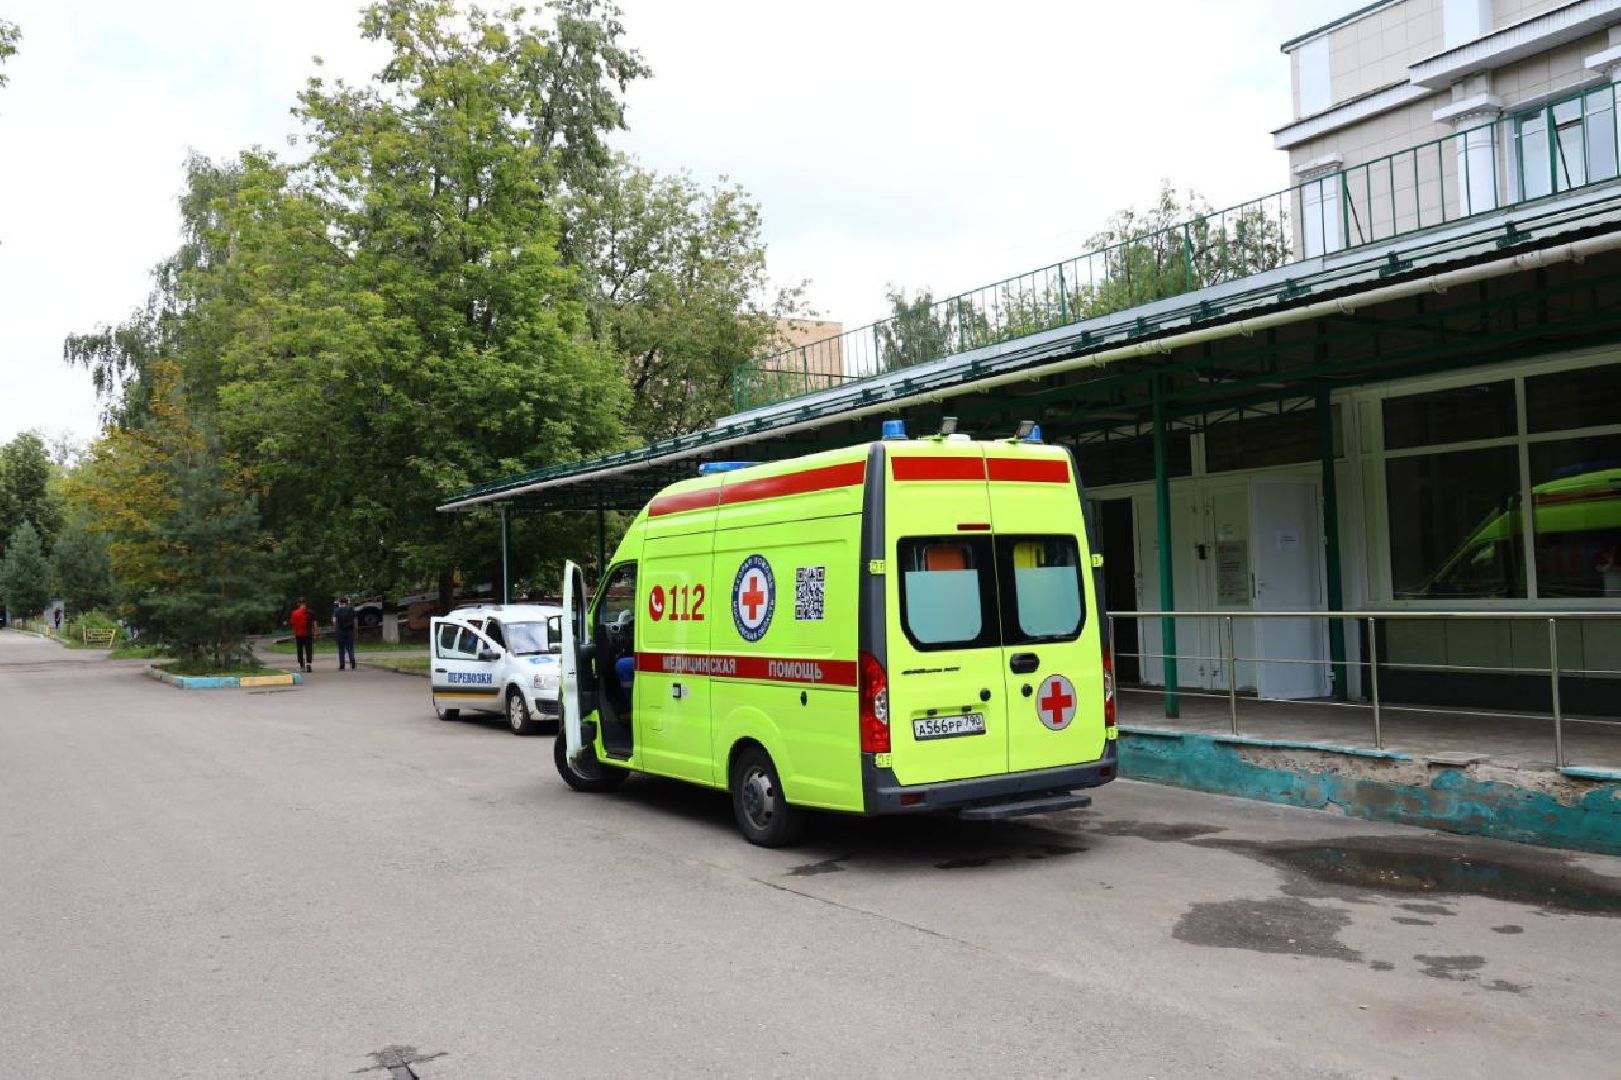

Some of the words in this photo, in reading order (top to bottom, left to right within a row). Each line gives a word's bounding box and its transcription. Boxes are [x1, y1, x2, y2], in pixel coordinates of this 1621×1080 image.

[669, 583, 704, 621] 112
[447, 672, 493, 684] ПЕРЕВОЗКИ
[662, 655, 736, 675] МЕДИЦИНСКАЯ
[768, 659, 823, 683] ПОМОЩЬ
